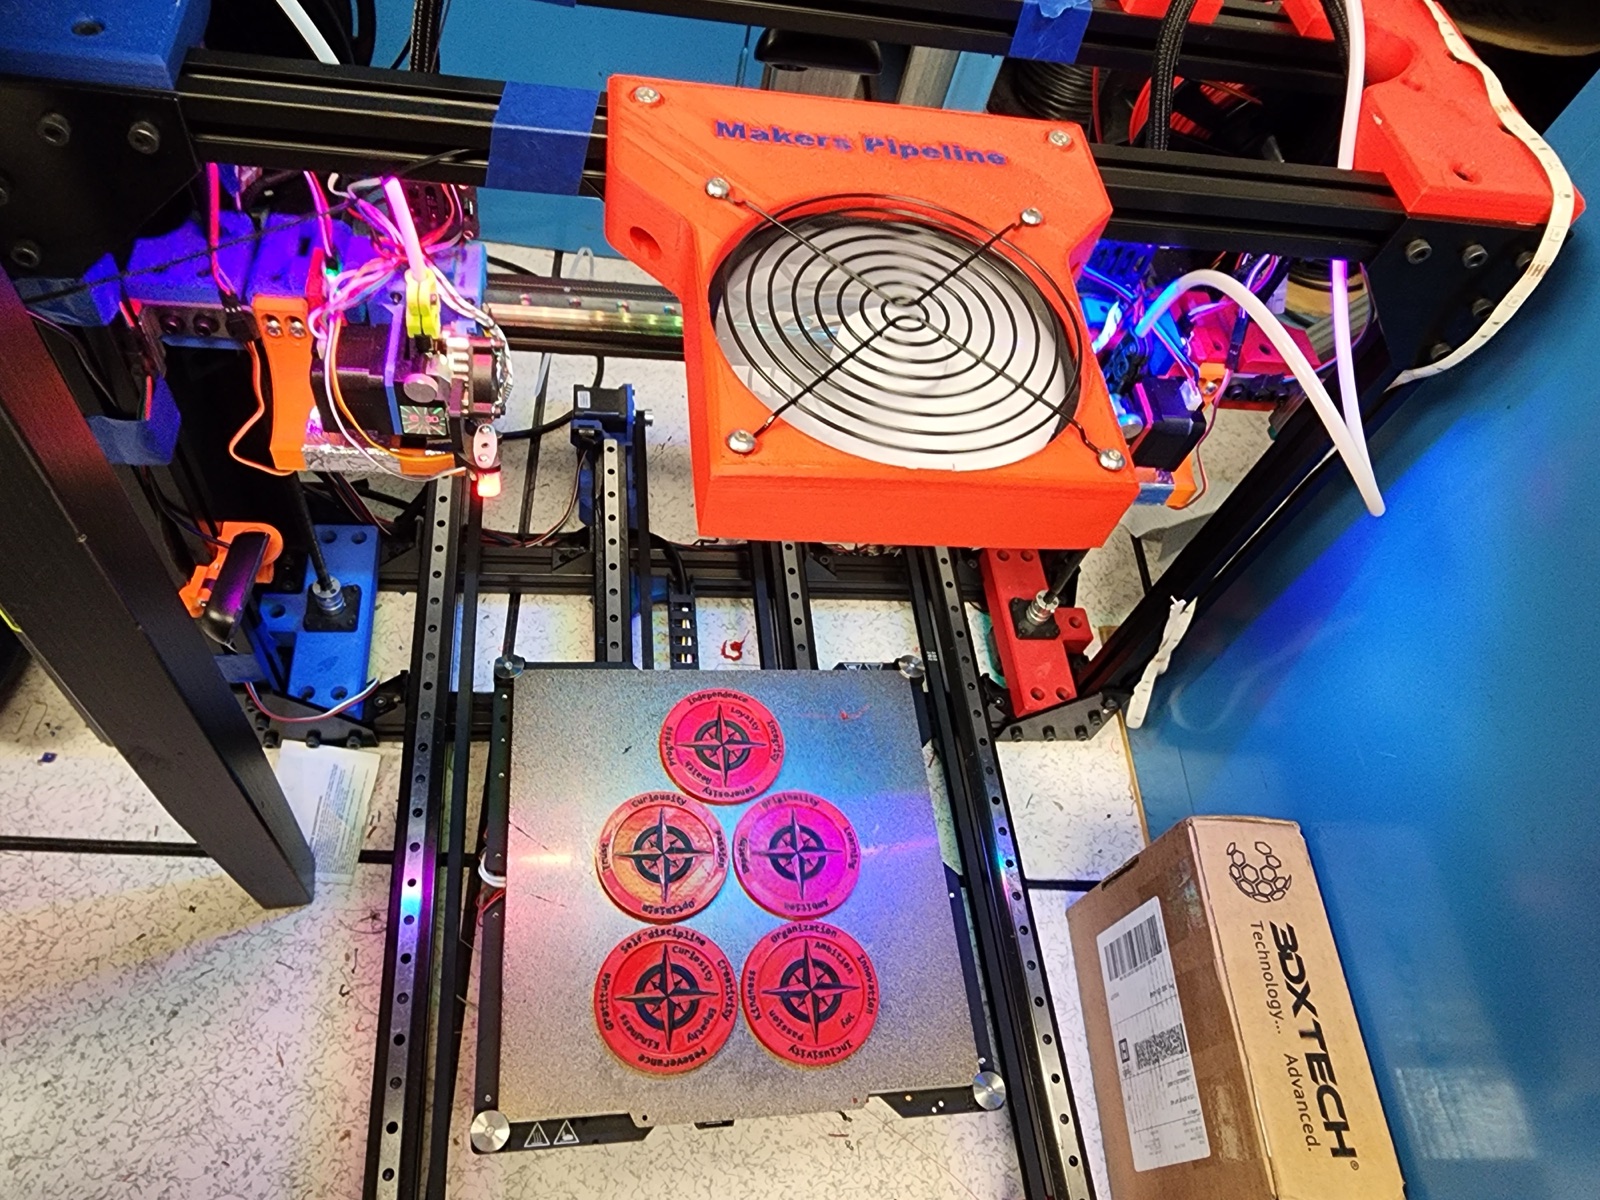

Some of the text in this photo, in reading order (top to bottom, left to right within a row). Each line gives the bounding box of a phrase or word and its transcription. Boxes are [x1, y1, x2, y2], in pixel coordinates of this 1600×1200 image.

[715, 120, 1007, 165] Makers Pipeline
[688, 691, 748, 705] Independence
[731, 707, 760, 731] Loyalty
[664, 726, 677, 766] Progress
[767, 720, 782, 763] Integrity
[702, 786, 756, 798] Generosity
[761, 793, 820, 808] Originality
[600, 843, 611, 871] Trust
[715, 830, 725, 868] Passion
[844, 826, 858, 870] Learning
[642, 900, 695, 915] Optimism
[770, 923, 837, 943] Organization
[672, 945, 714, 982] Curiosity
[814, 941, 854, 975] Ambition
[599, 972, 615, 1031] Gratitude
[717, 959, 736, 1022] Creativity
[747, 970, 763, 1021] Kindness
[857, 954, 876, 1015] Innovation
[619, 1013, 660, 1050] Kindness
[687, 1007, 717, 1043] Empathy
[768, 1009, 804, 1042] Passion
[840, 1012, 856, 1029] Joy
[788, 1039, 854, 1060] Inclusivity
[1284, 1053, 1321, 1152] Advanced.
